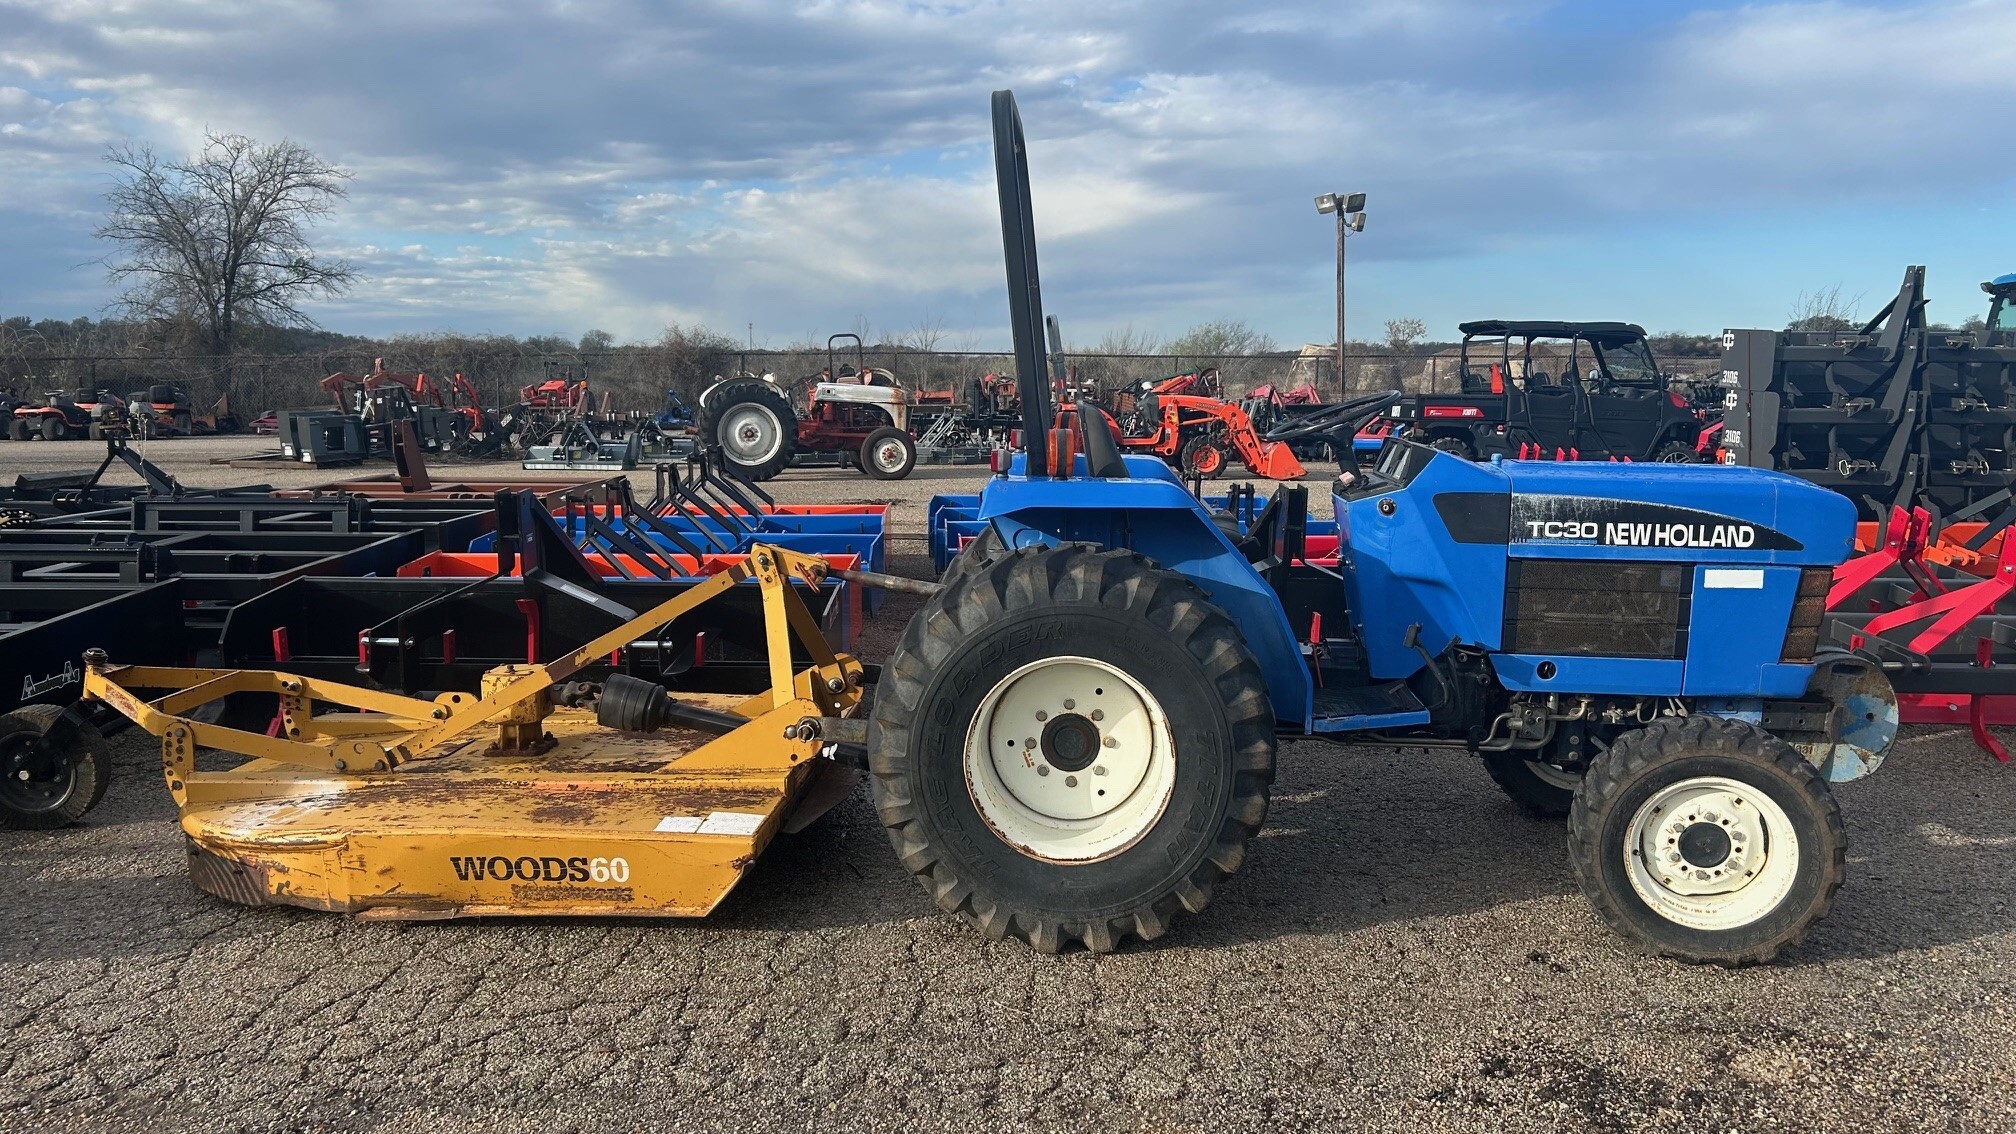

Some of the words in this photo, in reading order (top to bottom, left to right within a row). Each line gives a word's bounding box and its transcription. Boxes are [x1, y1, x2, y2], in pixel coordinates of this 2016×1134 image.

[1722, 370, 1739, 384] 3106
[1724, 429, 1741, 444] 3106
[1527, 521, 1598, 538] TC30
[1605, 523, 1652, 545] NEW
[1655, 524, 1755, 548] HOLLAND
[927, 620, 1064, 752] LOADER
[1167, 731, 1218, 868] TITAN
